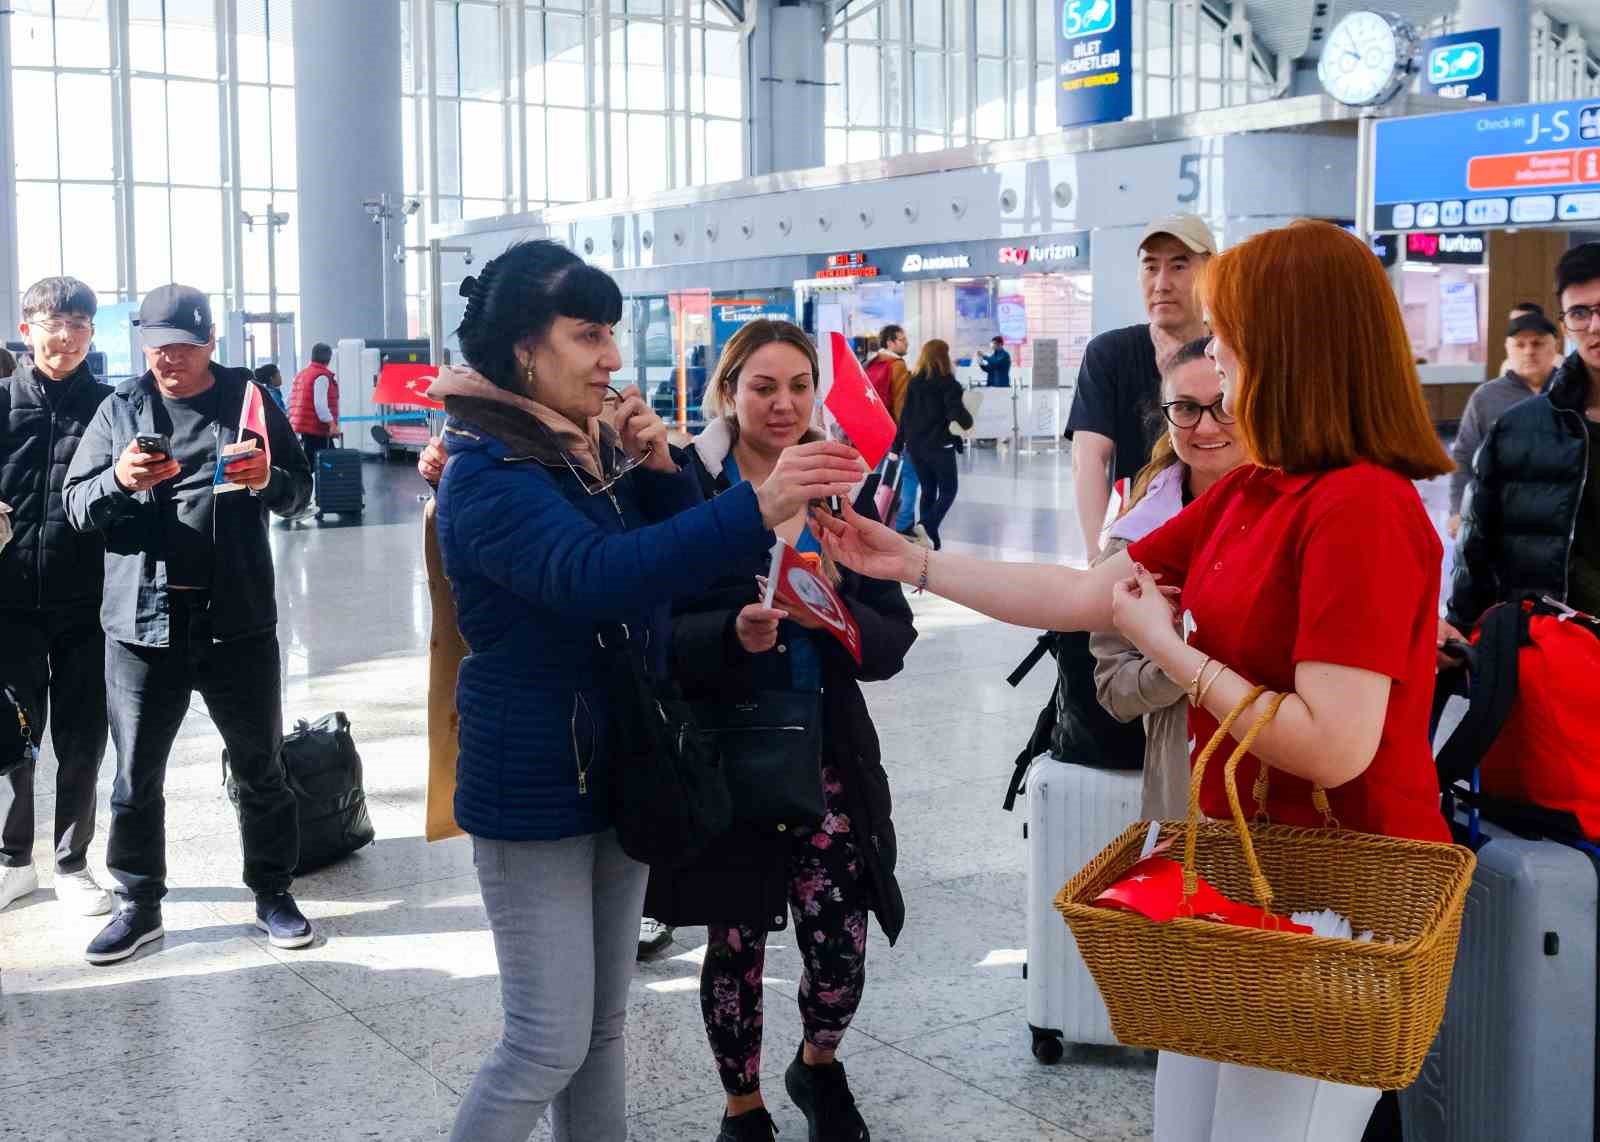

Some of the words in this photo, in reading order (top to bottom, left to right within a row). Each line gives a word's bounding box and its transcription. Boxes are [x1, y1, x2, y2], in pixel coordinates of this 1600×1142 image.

[1067, 1, 1081, 33] 5
[1434, 51, 1450, 78] 5
[1477, 116, 1525, 131] Check-in
[1525, 109, 1570, 144] J-S
[1177, 153, 1201, 202] 5
